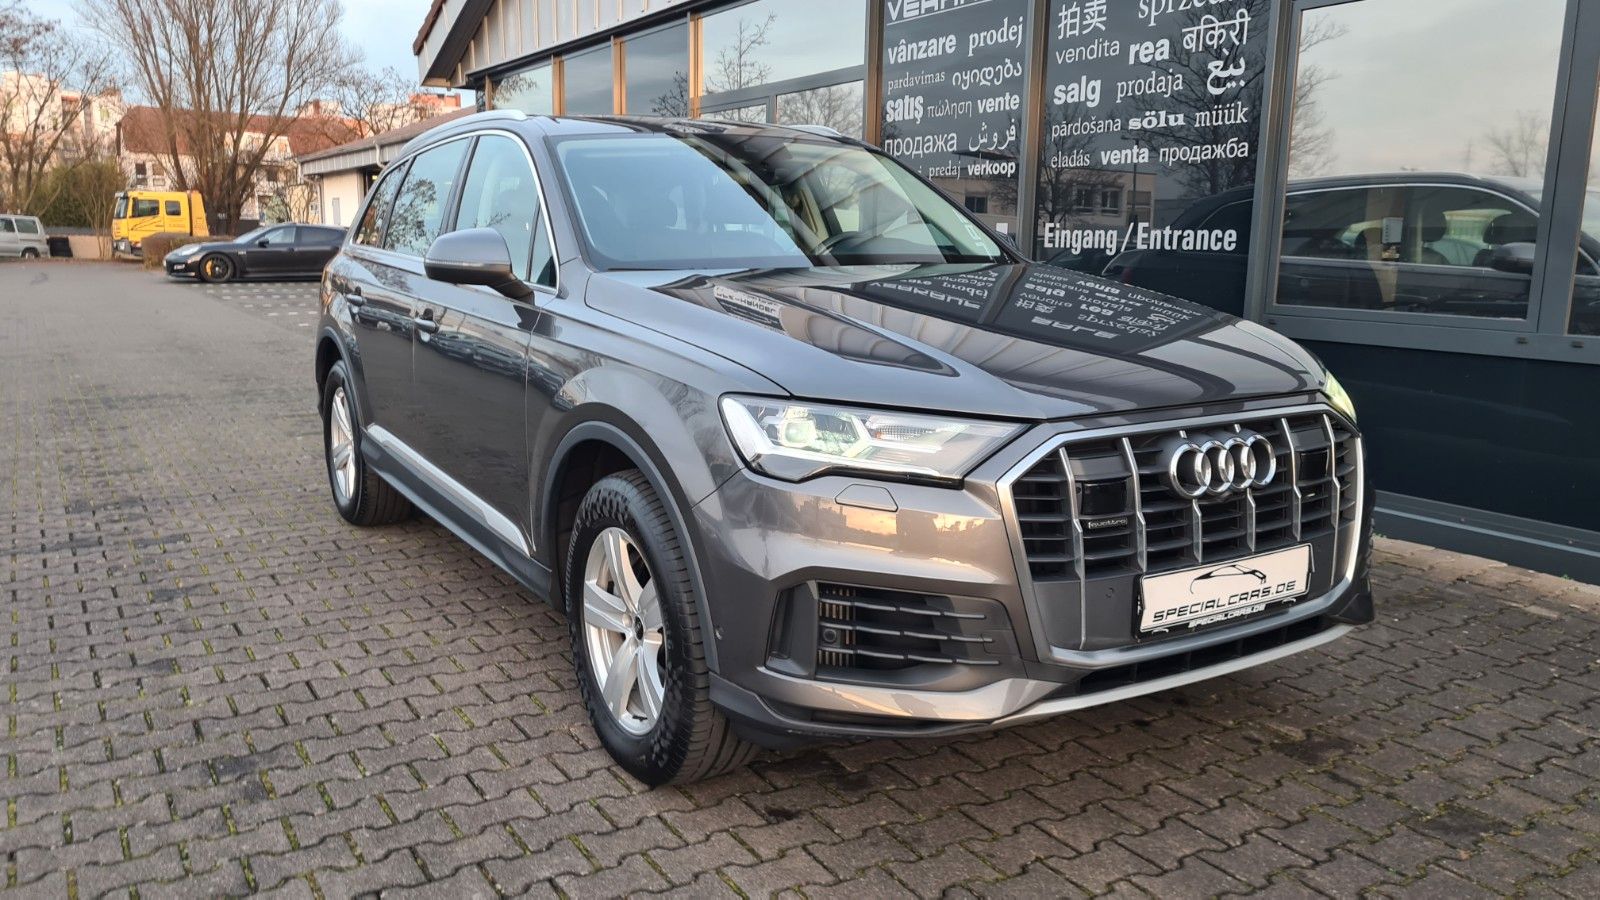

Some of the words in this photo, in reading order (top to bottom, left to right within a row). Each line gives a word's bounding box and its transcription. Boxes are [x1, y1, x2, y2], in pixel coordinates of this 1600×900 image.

[1057, 0, 1108, 40] 拍卖
[887, 34, 957, 65] vânzare
[968, 16, 1024, 57] prodej
[1055, 38, 1121, 65] vendita
[1128, 38, 1170, 65] rea
[887, 70, 946, 95] pardavimas
[952, 58, 1023, 90] იყიდება
[1053, 75, 1102, 108] salg
[1116, 68, 1184, 103] prodaja
[886, 95, 924, 124] satış
[927, 99, 972, 118] πώληση
[977, 92, 1020, 114] vente
[968, 118, 1017, 152] فروش
[1051, 116, 1122, 142] pārdošana
[1128, 110, 1186, 130] sölu
[1194, 101, 1249, 128] müük
[884, 132, 958, 159] продажа
[1050, 149, 1091, 168] eladás
[1101, 144, 1150, 165] venta
[1159, 138, 1249, 166] продажба
[928, 160, 961, 180] predaj
[967, 161, 1016, 177] verkoop
[1152, 580, 1297, 623] SPECIALCARS.DE
